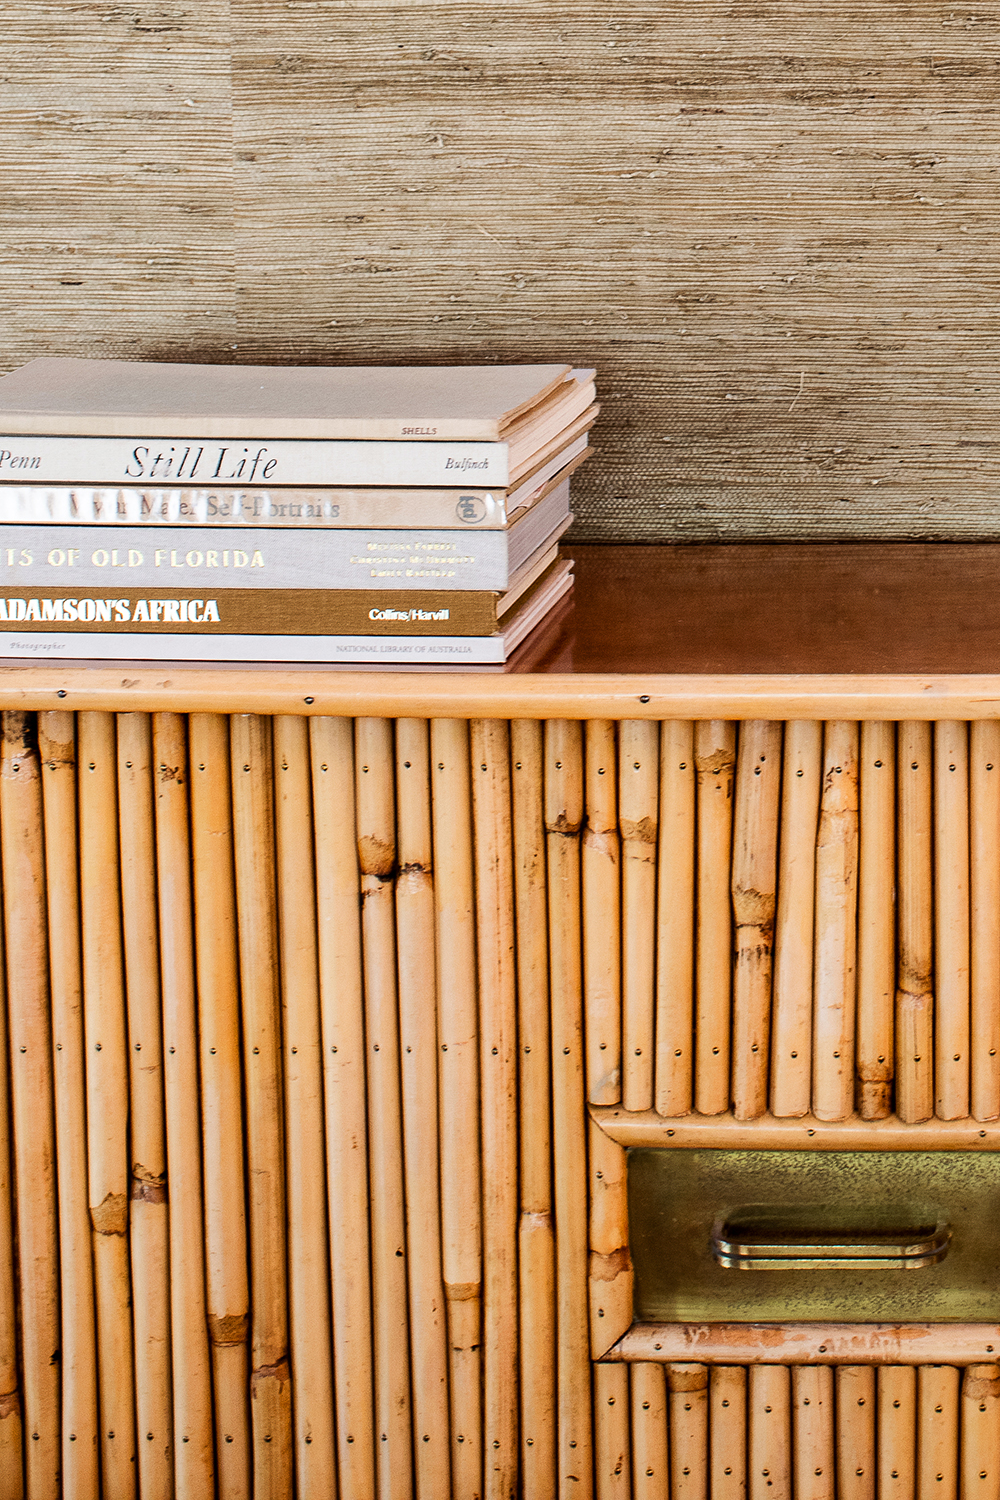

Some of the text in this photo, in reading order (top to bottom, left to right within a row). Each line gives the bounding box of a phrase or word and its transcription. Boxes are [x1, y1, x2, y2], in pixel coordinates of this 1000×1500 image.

[401, 427, 438, 435] SHELLS
[0, 446, 489, 481] Penn Still Life Bulfinch
[207, 495, 341, 518] Sef-Portrais
[0, 548, 266, 569] TS OF OLD FLORIDA
[132, 599, 221, 622] AFRICA
[336, 645, 473, 653] NATIONAL LIBRARY OF AUSTRALIA
